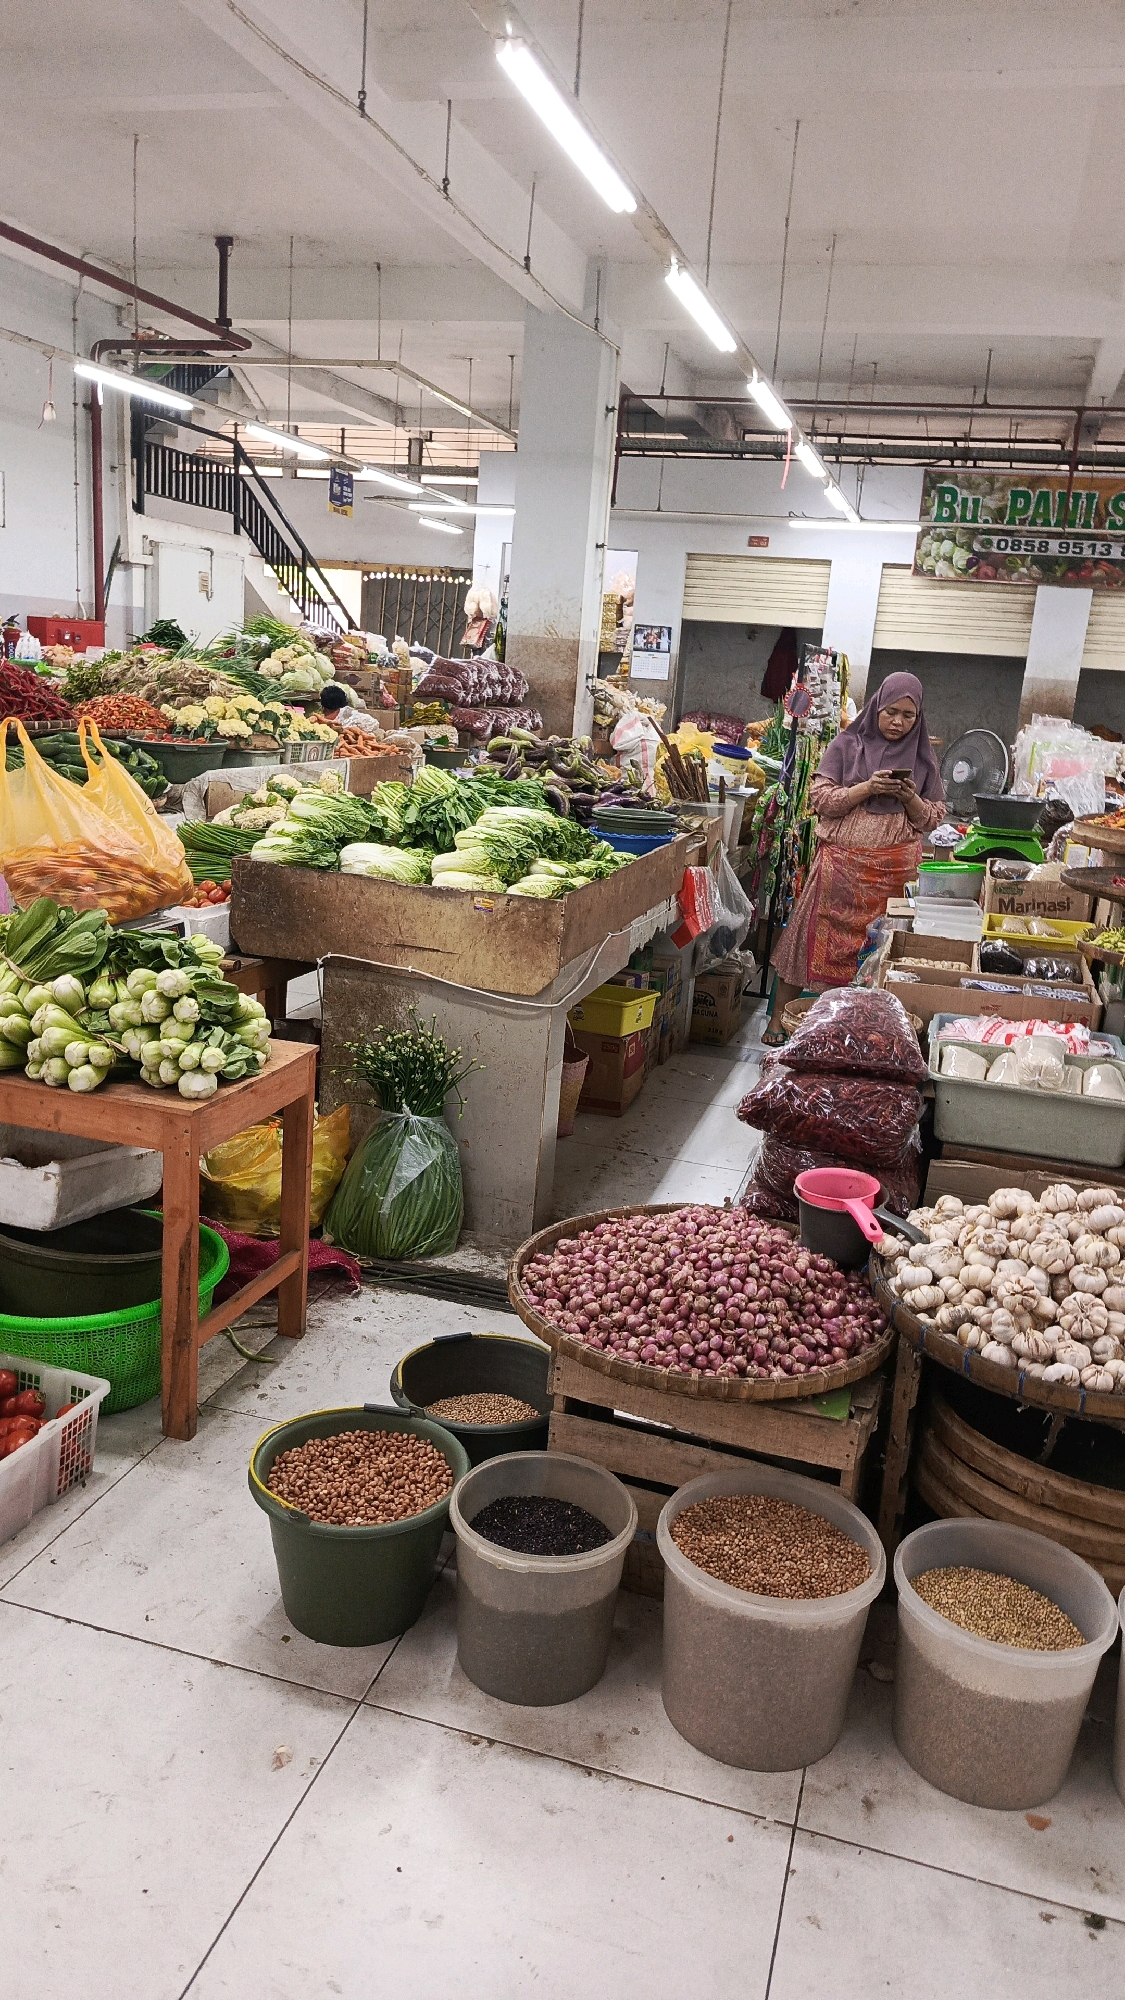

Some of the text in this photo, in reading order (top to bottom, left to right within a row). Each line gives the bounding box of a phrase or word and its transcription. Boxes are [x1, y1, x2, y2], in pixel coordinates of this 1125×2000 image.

[933, 484, 991, 524] Bu.
[1004, 487, 1098, 528] PANI
[997, 538, 1049, 553] 0858
[1058, 541, 1112, 556] 9513
[998, 897, 1071, 914] Marinasi
